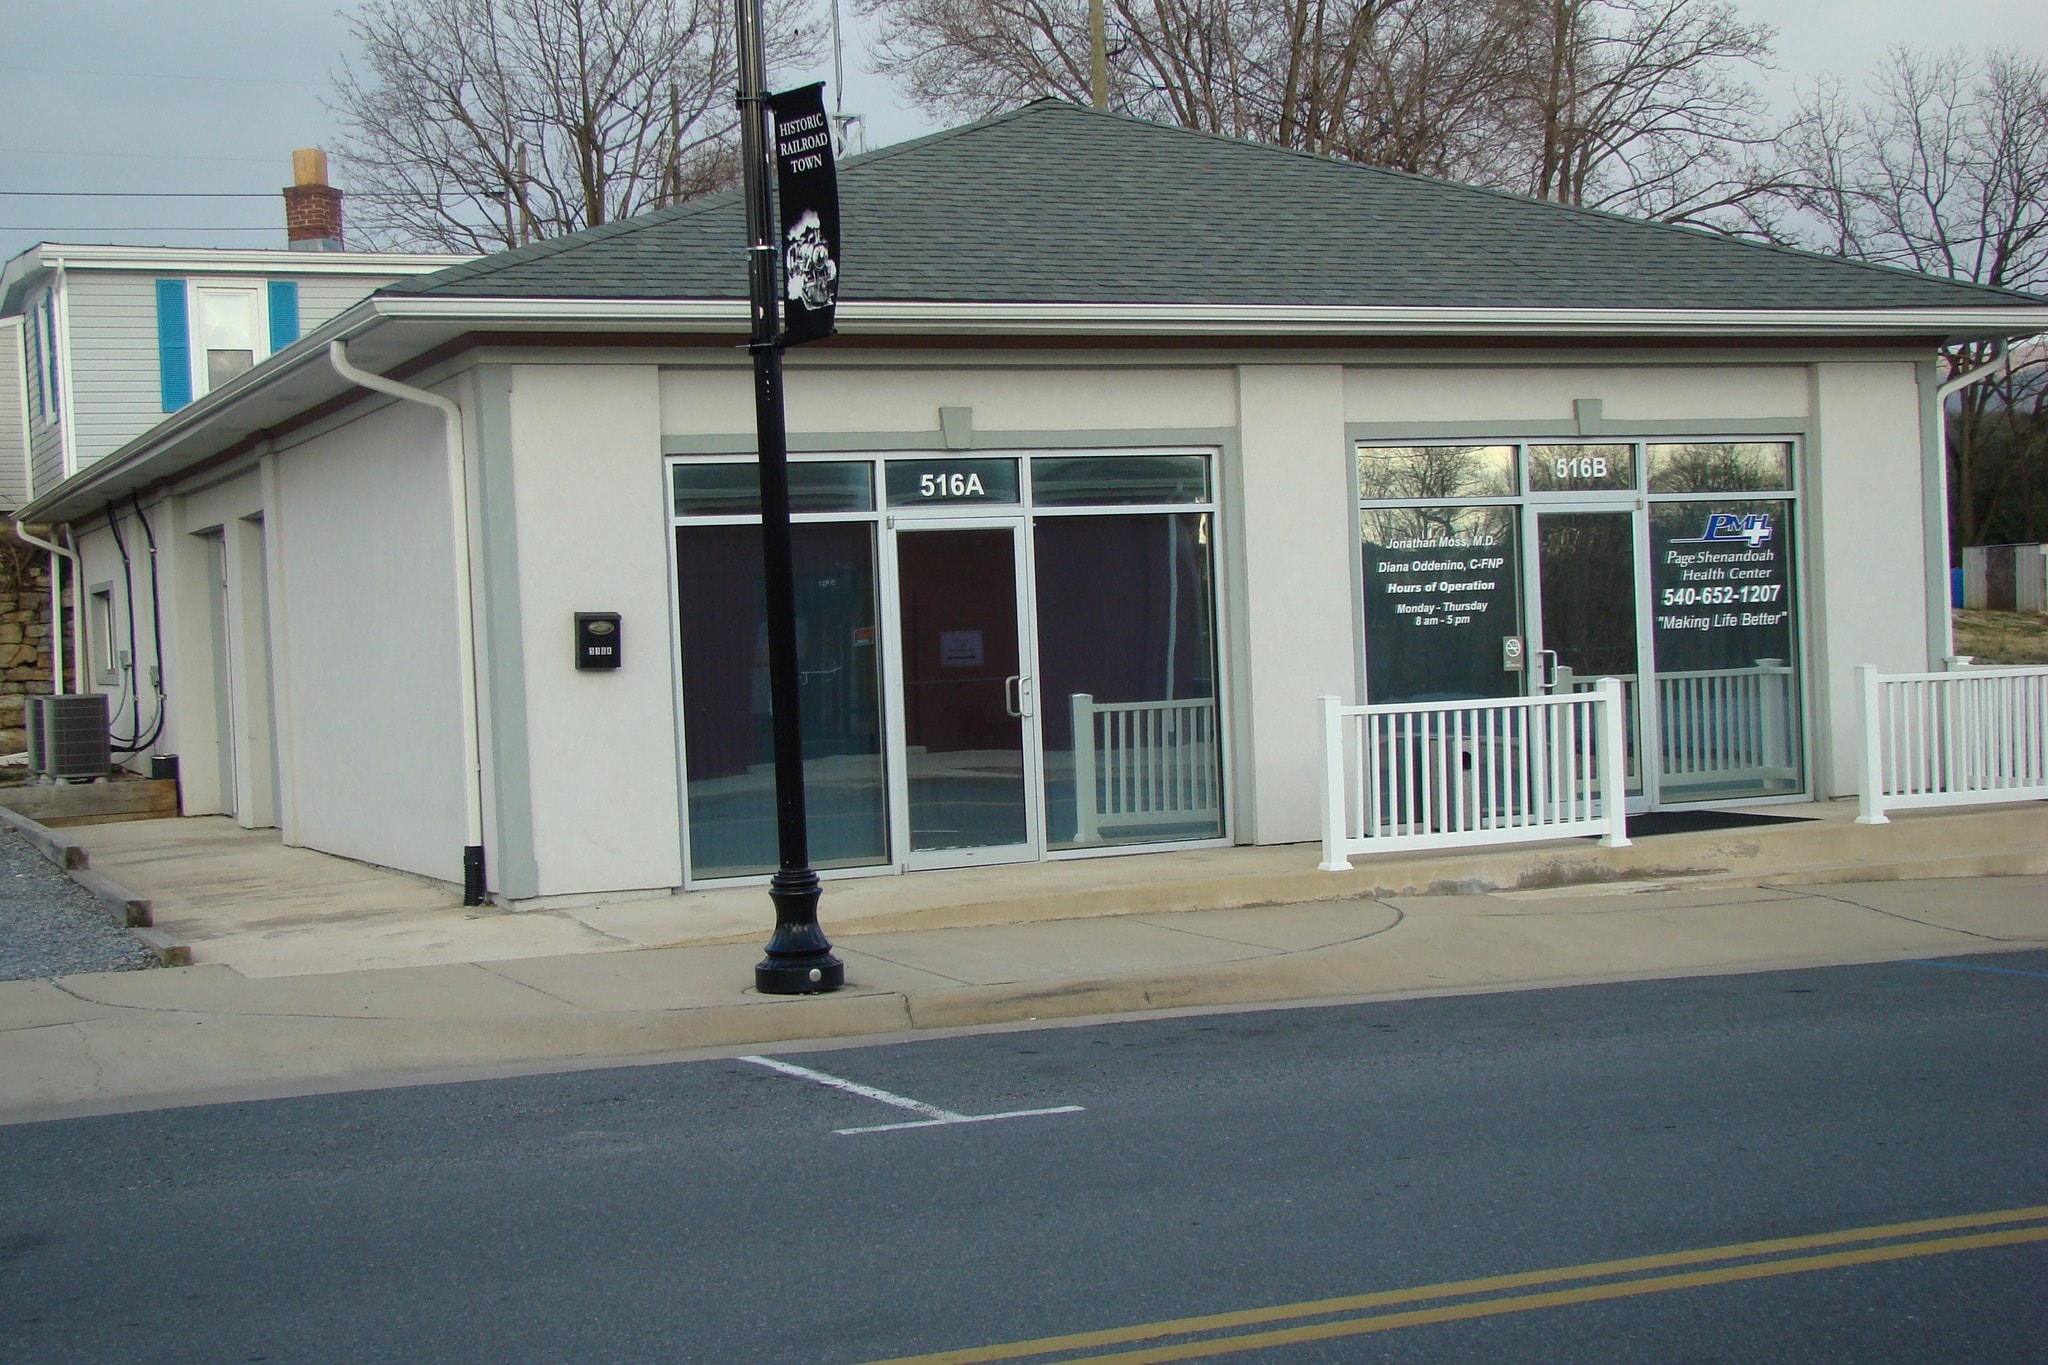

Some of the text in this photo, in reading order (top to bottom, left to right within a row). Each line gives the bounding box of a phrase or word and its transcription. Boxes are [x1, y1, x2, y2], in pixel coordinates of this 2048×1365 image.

[779, 112, 824, 137] HISTORIC
[780, 132, 828, 157] RAILROAD
[790, 153, 823, 174] TOWN
[1556, 457, 1607, 478] 516B
[919, 472, 985, 497] 516A
[1699, 513, 1770, 543] PMH
[1386, 535, 1497, 549] Jonathan Moss, M.D.
[1378, 557, 1504, 573] Diana Oddenino, C-FNP
[1666, 549, 1774, 568] Page Shenandoah
[1682, 567, 1772, 581] Health Center
[1387, 580, 1495, 594] Hours of Operation
[1663, 584, 1781, 606] 540-652-1207
[1396, 602, 1437, 615] Monday
[1443, 600, 1488, 613] Thursday
[1415, 616, 1422, 626] 8
[1423, 616, 1438, 626] am
[1446, 615, 1453, 625] 5
[1454, 615, 1471, 627] pm
[1658, 611, 1788, 631] "Making Life Better"
